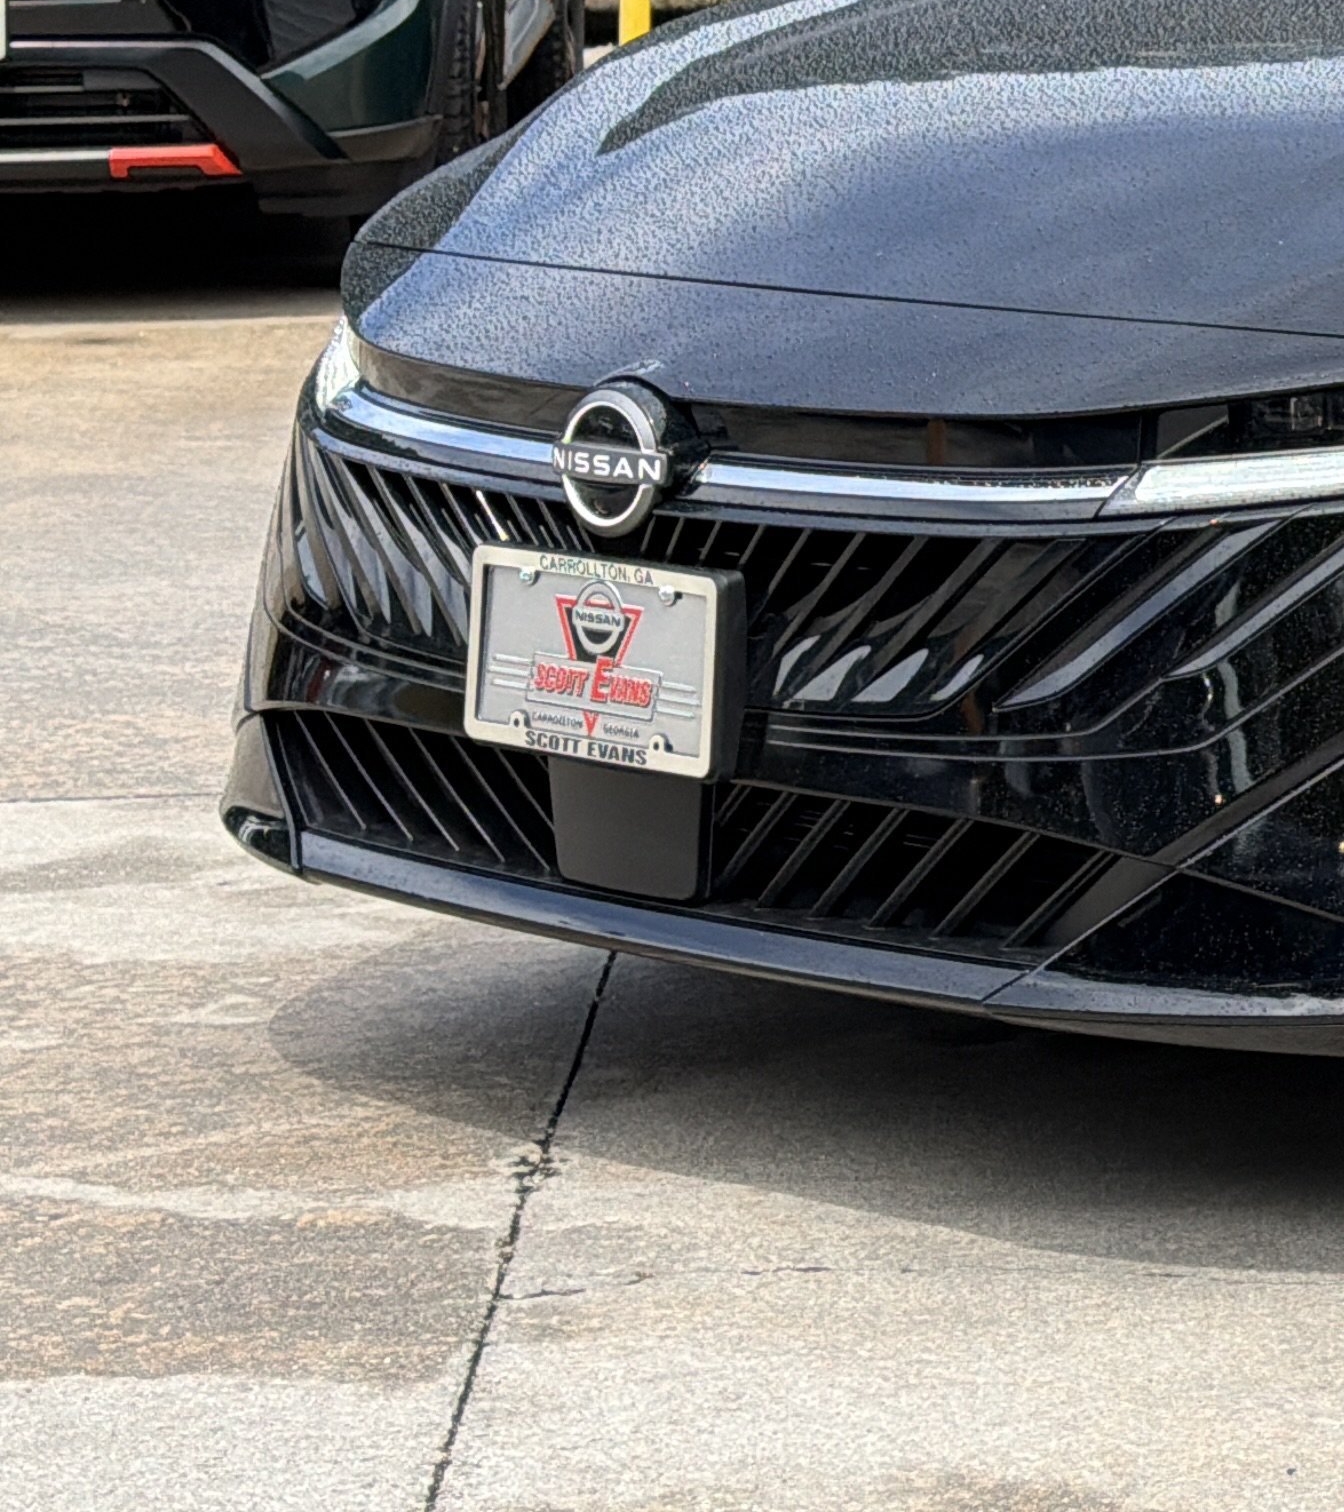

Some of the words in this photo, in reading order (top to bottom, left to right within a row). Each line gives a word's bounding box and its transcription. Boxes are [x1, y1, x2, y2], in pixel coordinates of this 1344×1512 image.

[552, 447, 661, 481] NISSAN
[540, 555, 630, 582] CARROLLTON,
[633, 568, 654, 585] GA
[574, 610, 621, 628] NISSAN
[534, 663, 588, 696] SCOTT
[525, 731, 581, 754] SCOTT
[587, 740, 648, 766] EVANS
